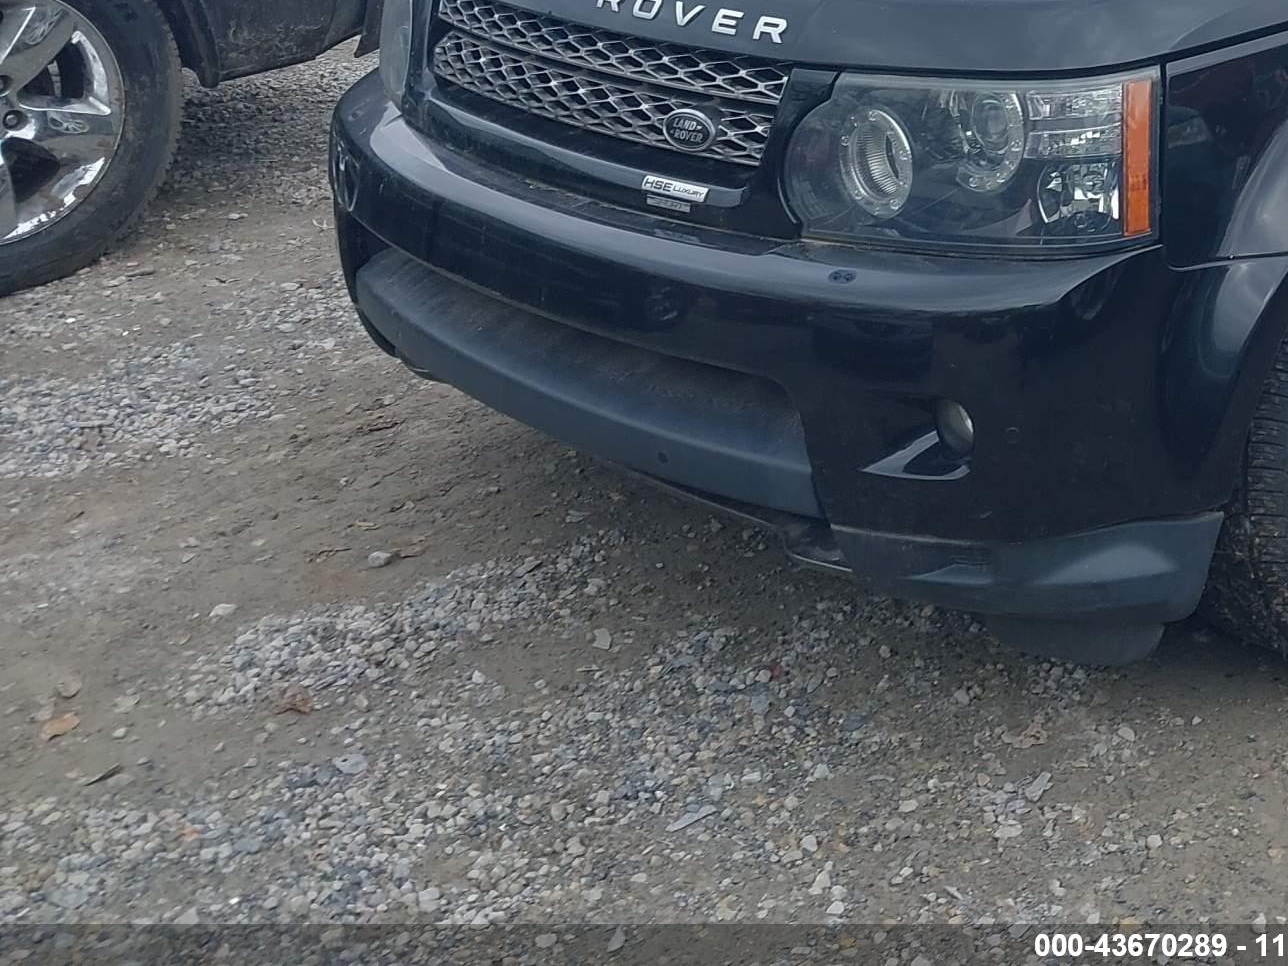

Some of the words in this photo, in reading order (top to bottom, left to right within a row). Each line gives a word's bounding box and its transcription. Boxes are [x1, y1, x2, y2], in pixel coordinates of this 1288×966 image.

[673, 117, 698, 131] LAND
[673, 129, 704, 143] ROVER
[643, 177, 674, 193] HSE
[672, 184, 705, 198] LUXURY
